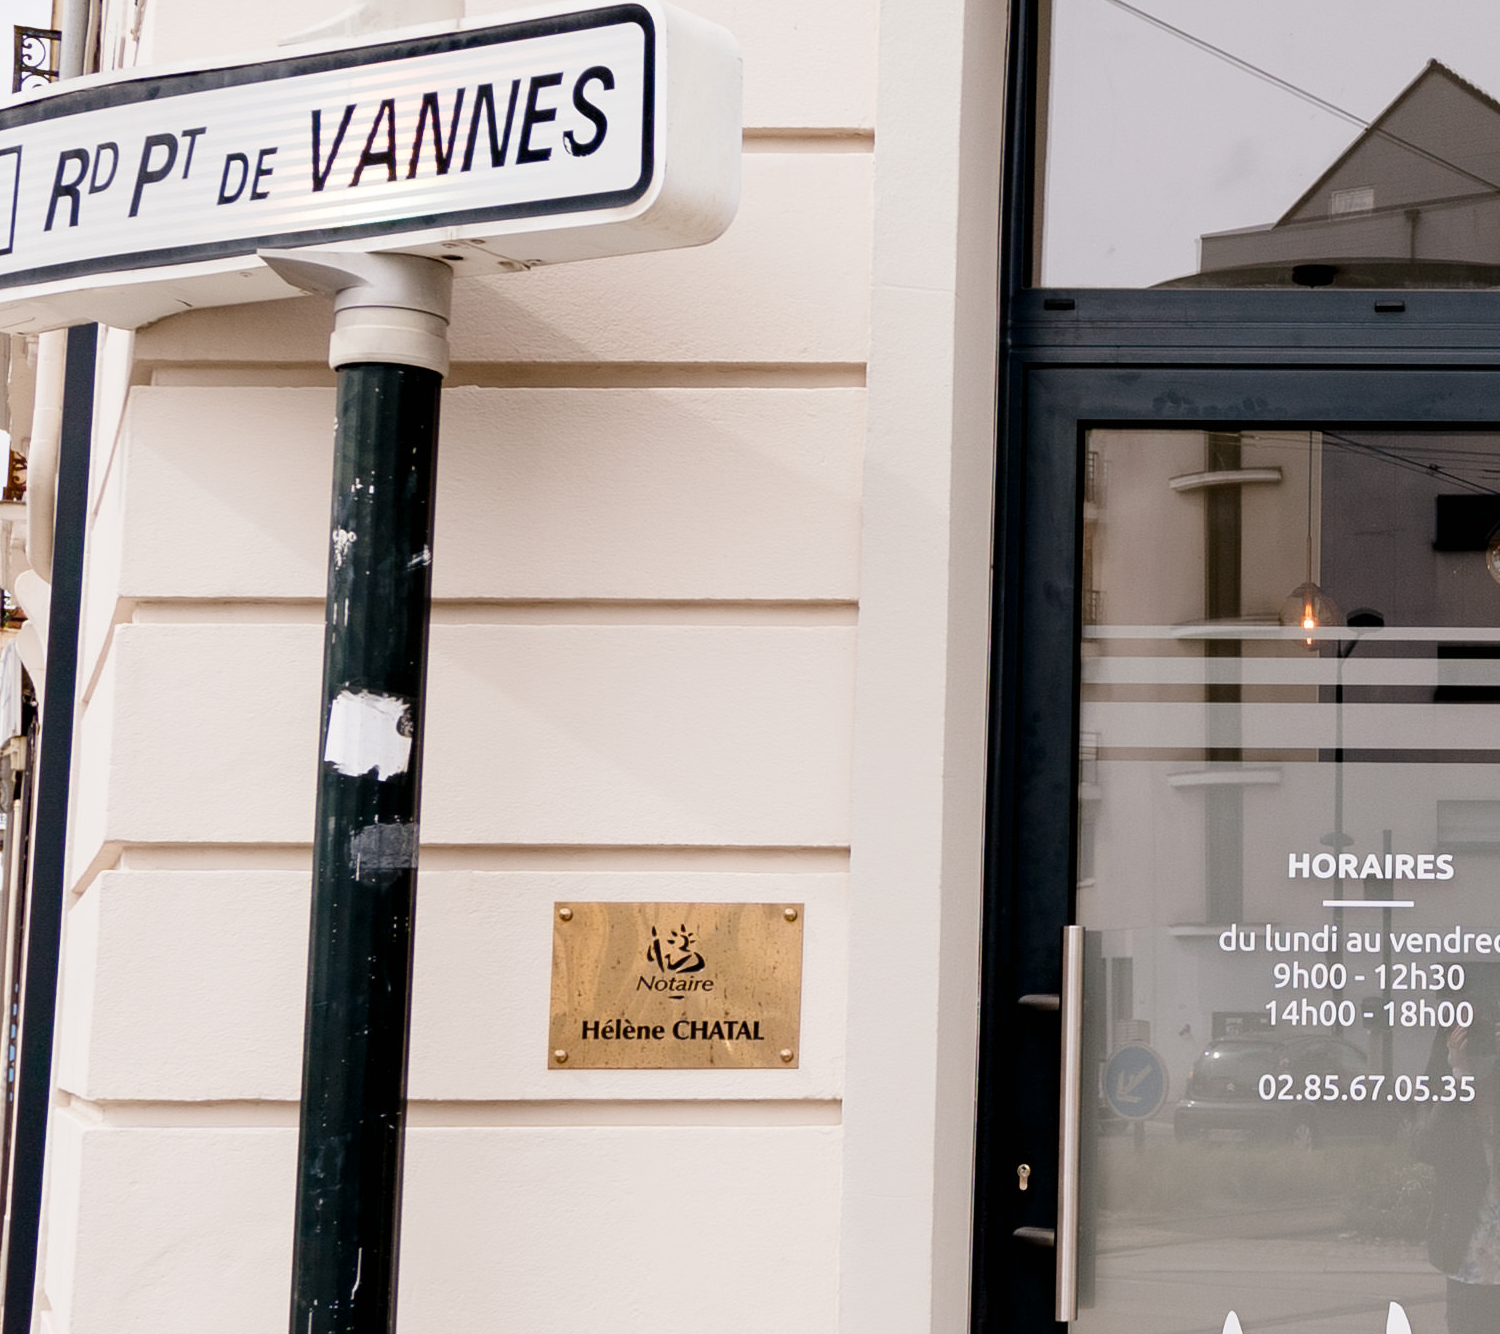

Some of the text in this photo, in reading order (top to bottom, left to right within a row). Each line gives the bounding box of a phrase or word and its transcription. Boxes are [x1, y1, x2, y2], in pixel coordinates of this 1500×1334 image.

[216, 146, 278, 206] DE
[309, 65, 615, 193] VANNES
[1287, 853, 1455, 880] HORAIRES
[1219, 924, 1256, 952] du
[1265, 924, 1338, 953] lundi
[1346, 932, 1381, 953] au
[636, 975, 714, 992] Notaire
[1273, 963, 1347, 990] 9h00
[1374, 964, 1465, 991] 12h30
[1265, 999, 1356, 1026] 14h00
[1383, 1000, 1474, 1028] 18h00
[581, 1019, 764, 1041] Hélène CHATAL
[1258, 1074, 1476, 1102] 02.85.67.05.35
